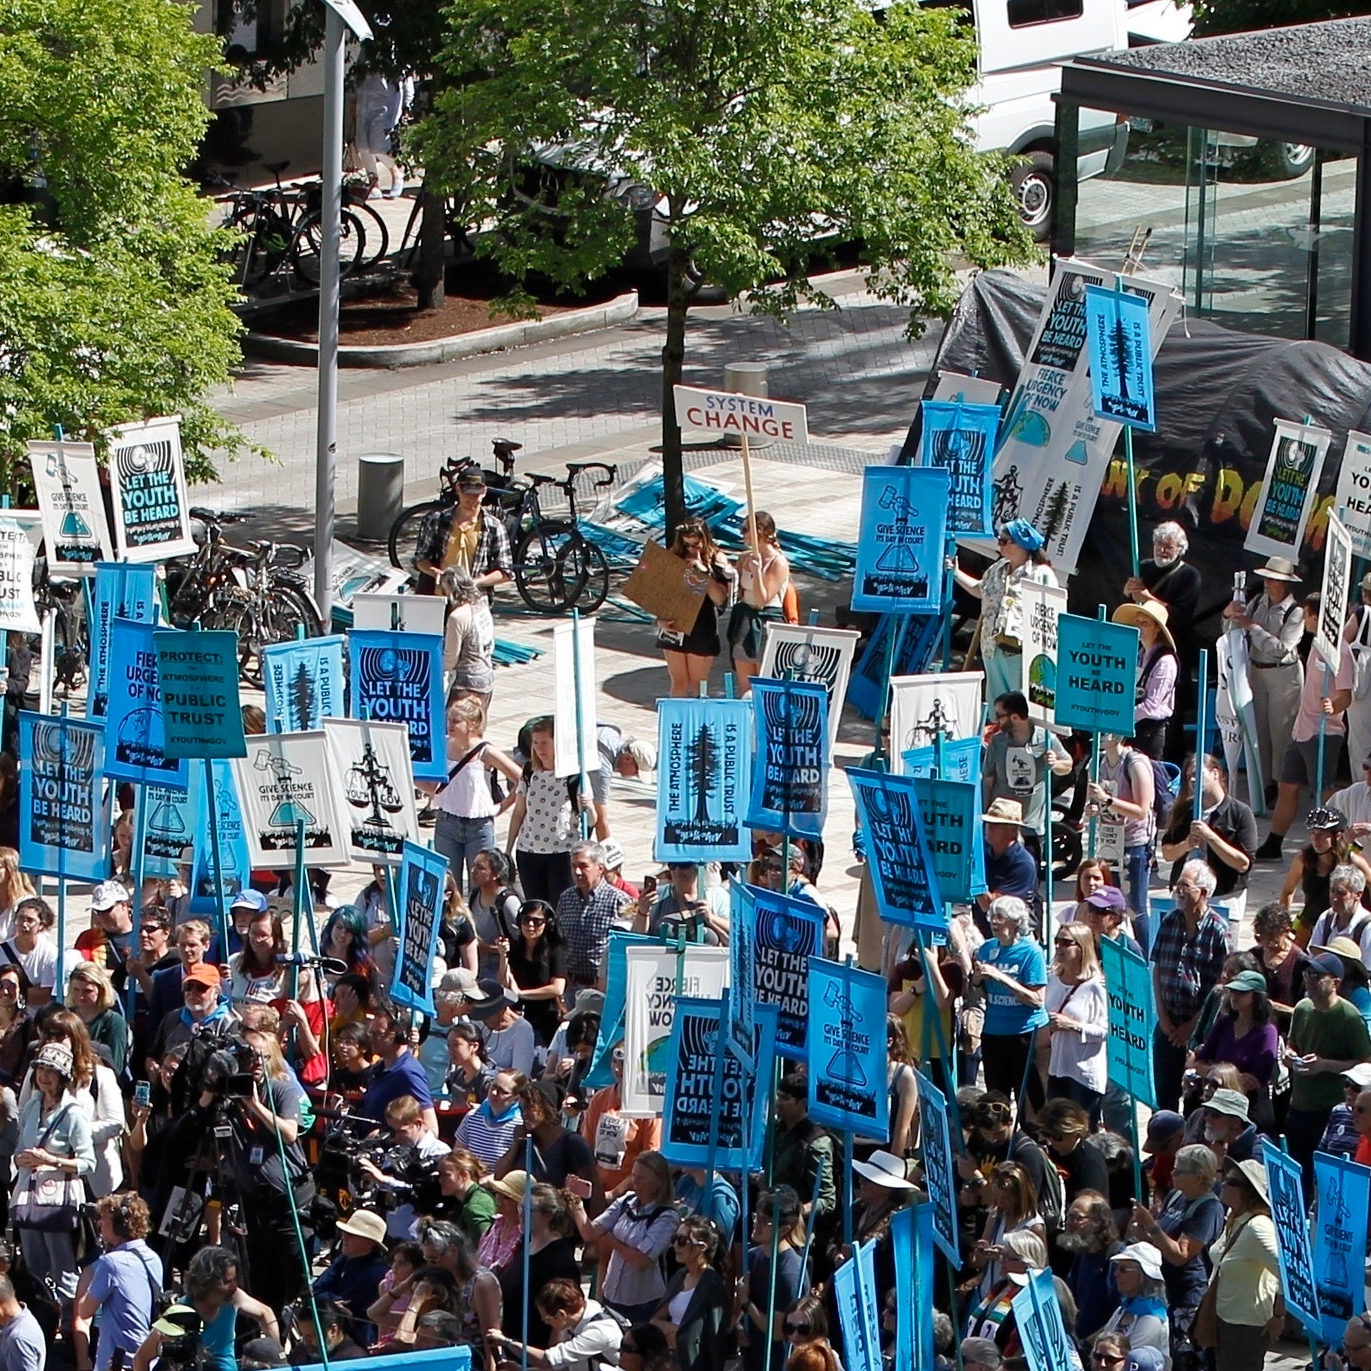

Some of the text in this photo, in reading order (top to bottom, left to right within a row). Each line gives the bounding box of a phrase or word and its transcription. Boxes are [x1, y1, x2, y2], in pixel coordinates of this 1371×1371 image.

[706, 396, 774, 418] SYSTEM
[687, 407, 794, 440] CHANGE
[126, 471, 169, 489] LET THE
[124, 483, 175, 510] YOUTH
[124, 503, 179, 524] BE HEARD
[160, 650, 223, 664] PROTECT:
[1082, 642, 1112, 652] LET THE
[1069, 650, 1126, 671] YOUTH
[162, 674, 225, 684] ATMOSPHERE
[1069, 678, 1125, 695] HEARD
[165, 693, 227, 708] PUBLIC
[169, 711, 224, 726] TRUST
[670, 722, 682, 812] THE ATMOSPHERE
[724, 724, 736, 814] IS A PUBLIC TRUST
[1110, 995, 1145, 1022] YOUTH
[1110, 1022, 1146, 1051] HEARD
